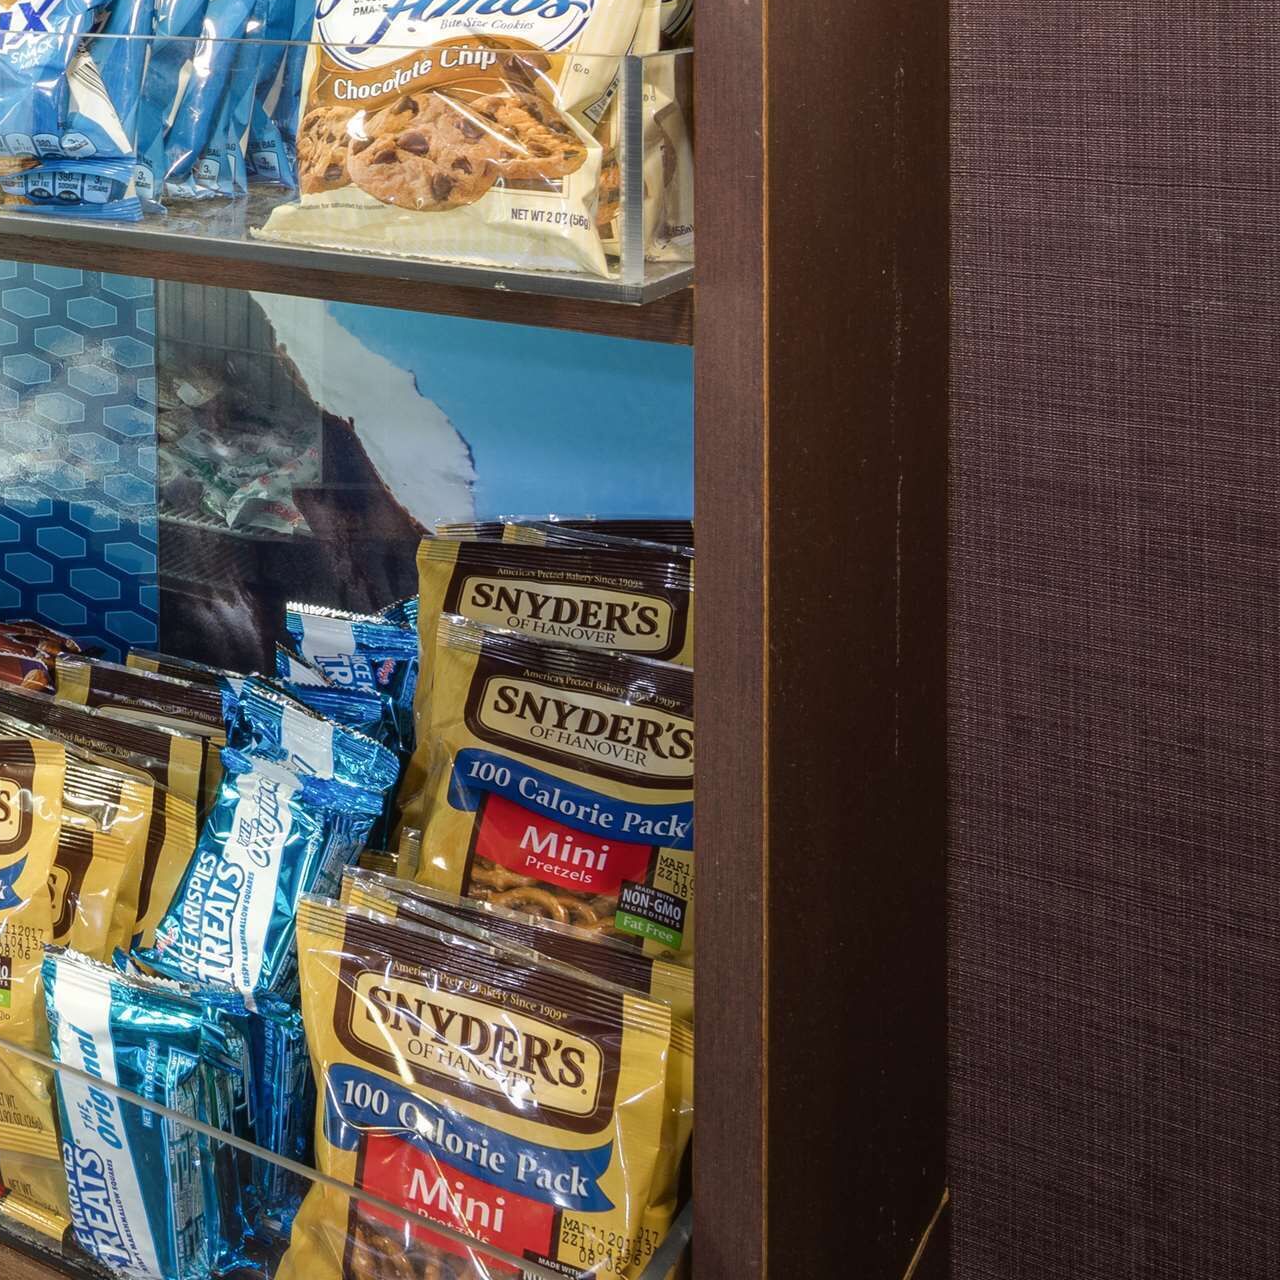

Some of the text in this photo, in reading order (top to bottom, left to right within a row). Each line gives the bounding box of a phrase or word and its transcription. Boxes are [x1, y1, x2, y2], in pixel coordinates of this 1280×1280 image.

[440, 18, 534, 30] Bite Size Cookies
[334, 43, 497, 102] Chocolate Chip
[511, 208, 529, 222] NET
[531, 209, 545, 223] WT
[547, 209, 553, 223] 2
[471, 582, 658, 638] SNYDER'S
[506, 615, 616, 645] OF HANOVER
[523, 668, 564, 686] America's
[565, 675, 593, 690] Pretzel
[529, 723, 648, 766] OF HANOVER
[469, 760, 687, 840] 100 Calorie Pack
[520, 825, 610, 870] Mini
[525, 855, 592, 883] Pretzels
[181, 851, 217, 977] RICE KRISPIES
[199, 861, 245, 984] TREATS
[621, 903, 680, 928] INGREDIENTS
[622, 889, 682, 920] NON-GMO
[623, 916, 673, 942] Fat Free
[367, 985, 585, 1089] SNYDER'S
[408, 1038, 433, 1057] OF
[341, 1078, 390, 1115] 100
[514, 1155, 590, 1197] Pack
[408, 1166, 506, 1234] Mini
